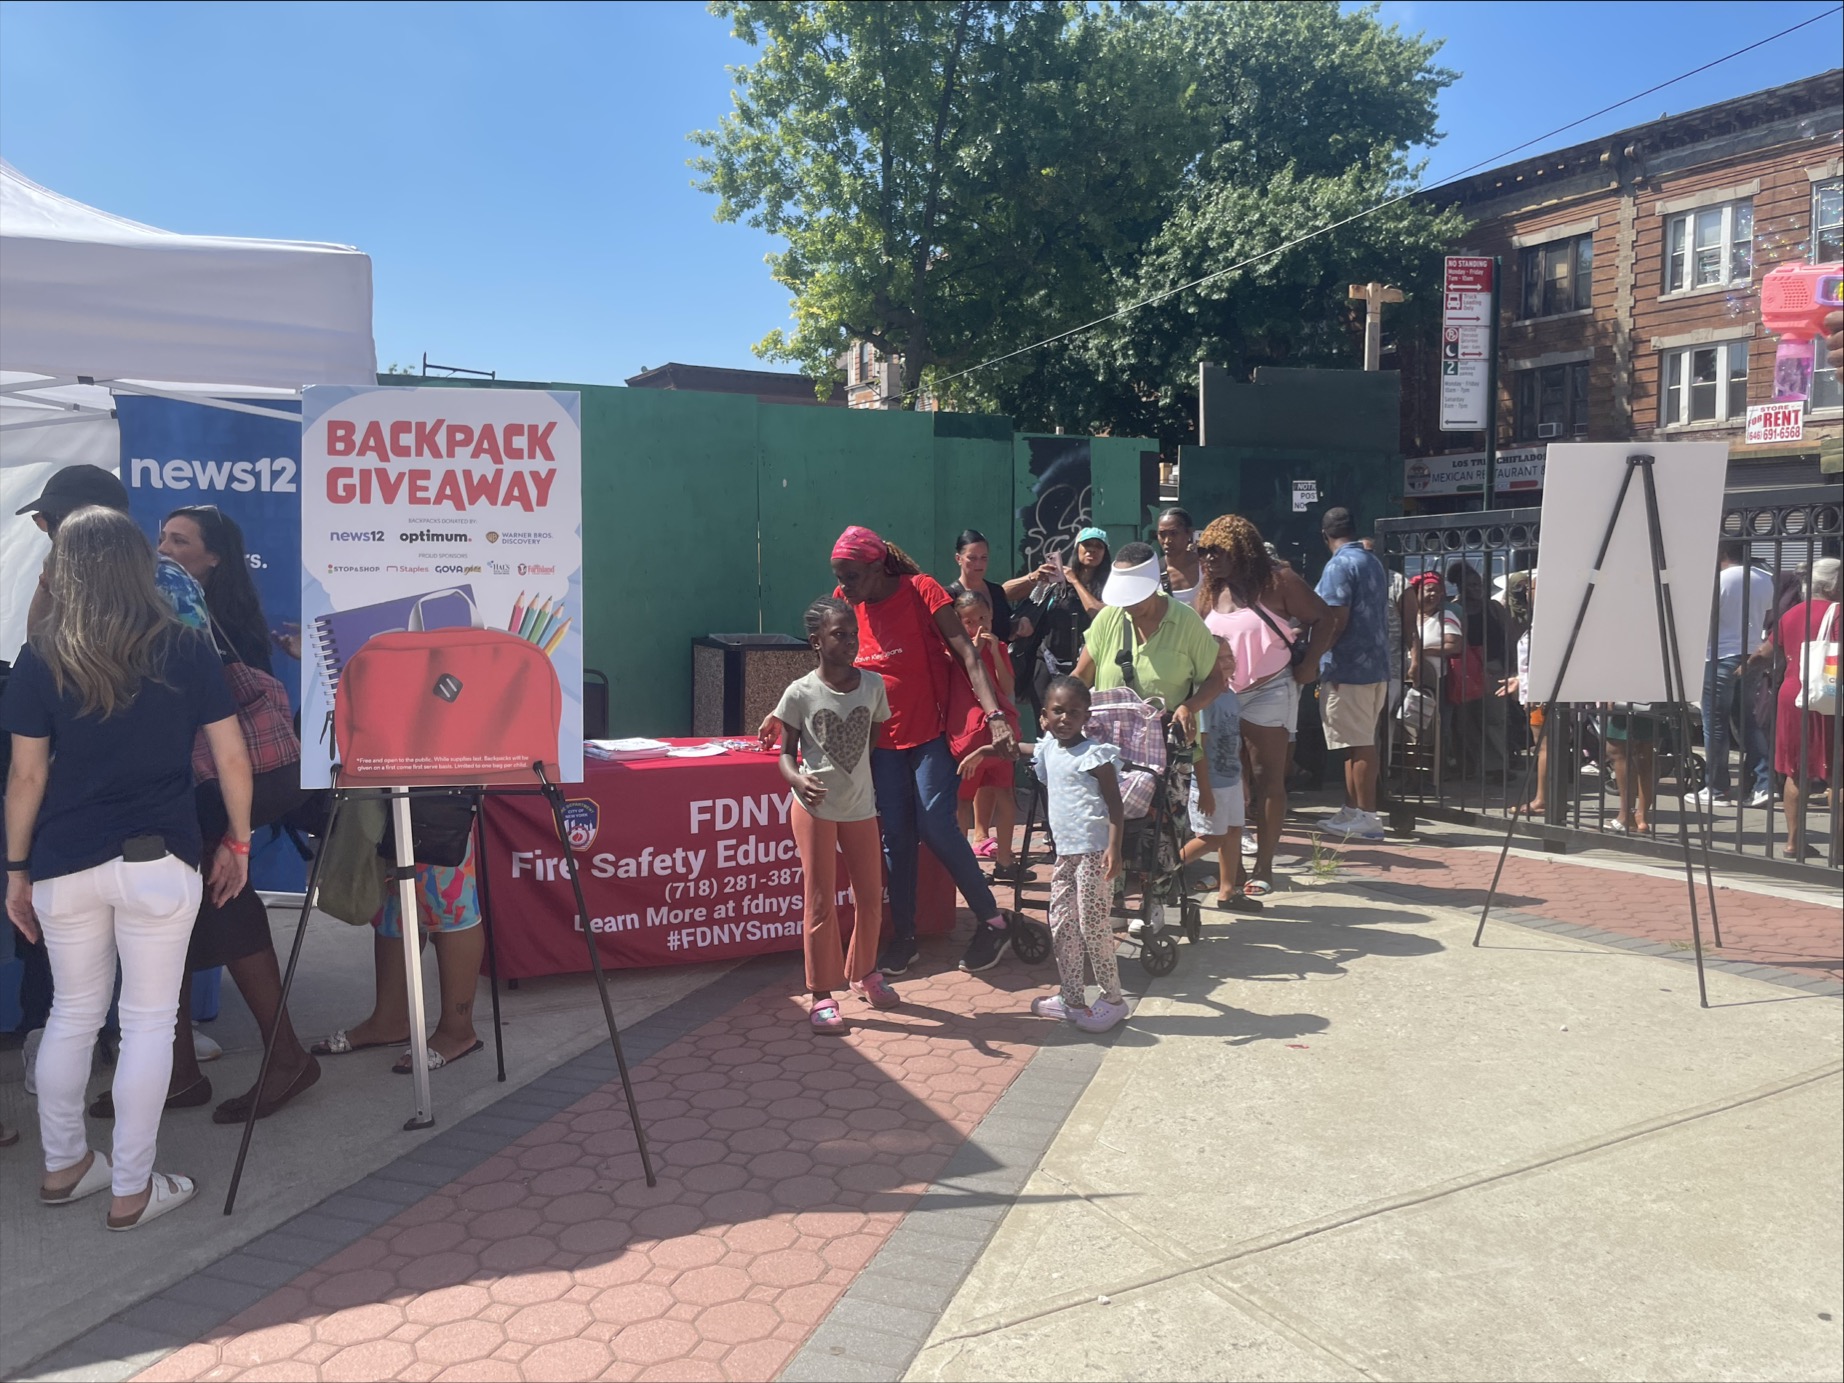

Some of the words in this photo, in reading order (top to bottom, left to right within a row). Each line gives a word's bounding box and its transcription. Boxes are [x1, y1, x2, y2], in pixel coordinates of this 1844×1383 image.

[1447, 361, 1455, 374] 2
[1748, 414, 1762, 428] FOR
[1763, 410, 1801, 428] RENT
[1763, 426, 1801, 440] 691-6568
[327, 419, 558, 465] BACKPACK
[131, 457, 296, 493] news12
[326, 467, 557, 512] GIVEAWAY
[1432, 471, 1473, 483] MEXICAN
[330, 531, 385, 542] news12
[690, 792, 796, 834] FDNY
[512, 850, 579, 881] Fire
[591, 847, 706, 879] Safety
[665, 878, 718, 903] (718)
[724, 867, 804, 894] 281-387
[574, 912, 639, 934] Learn
[646, 906, 706, 927] More
[713, 900, 735, 919] at
[667, 920, 804, 951] #FDNYSmar
